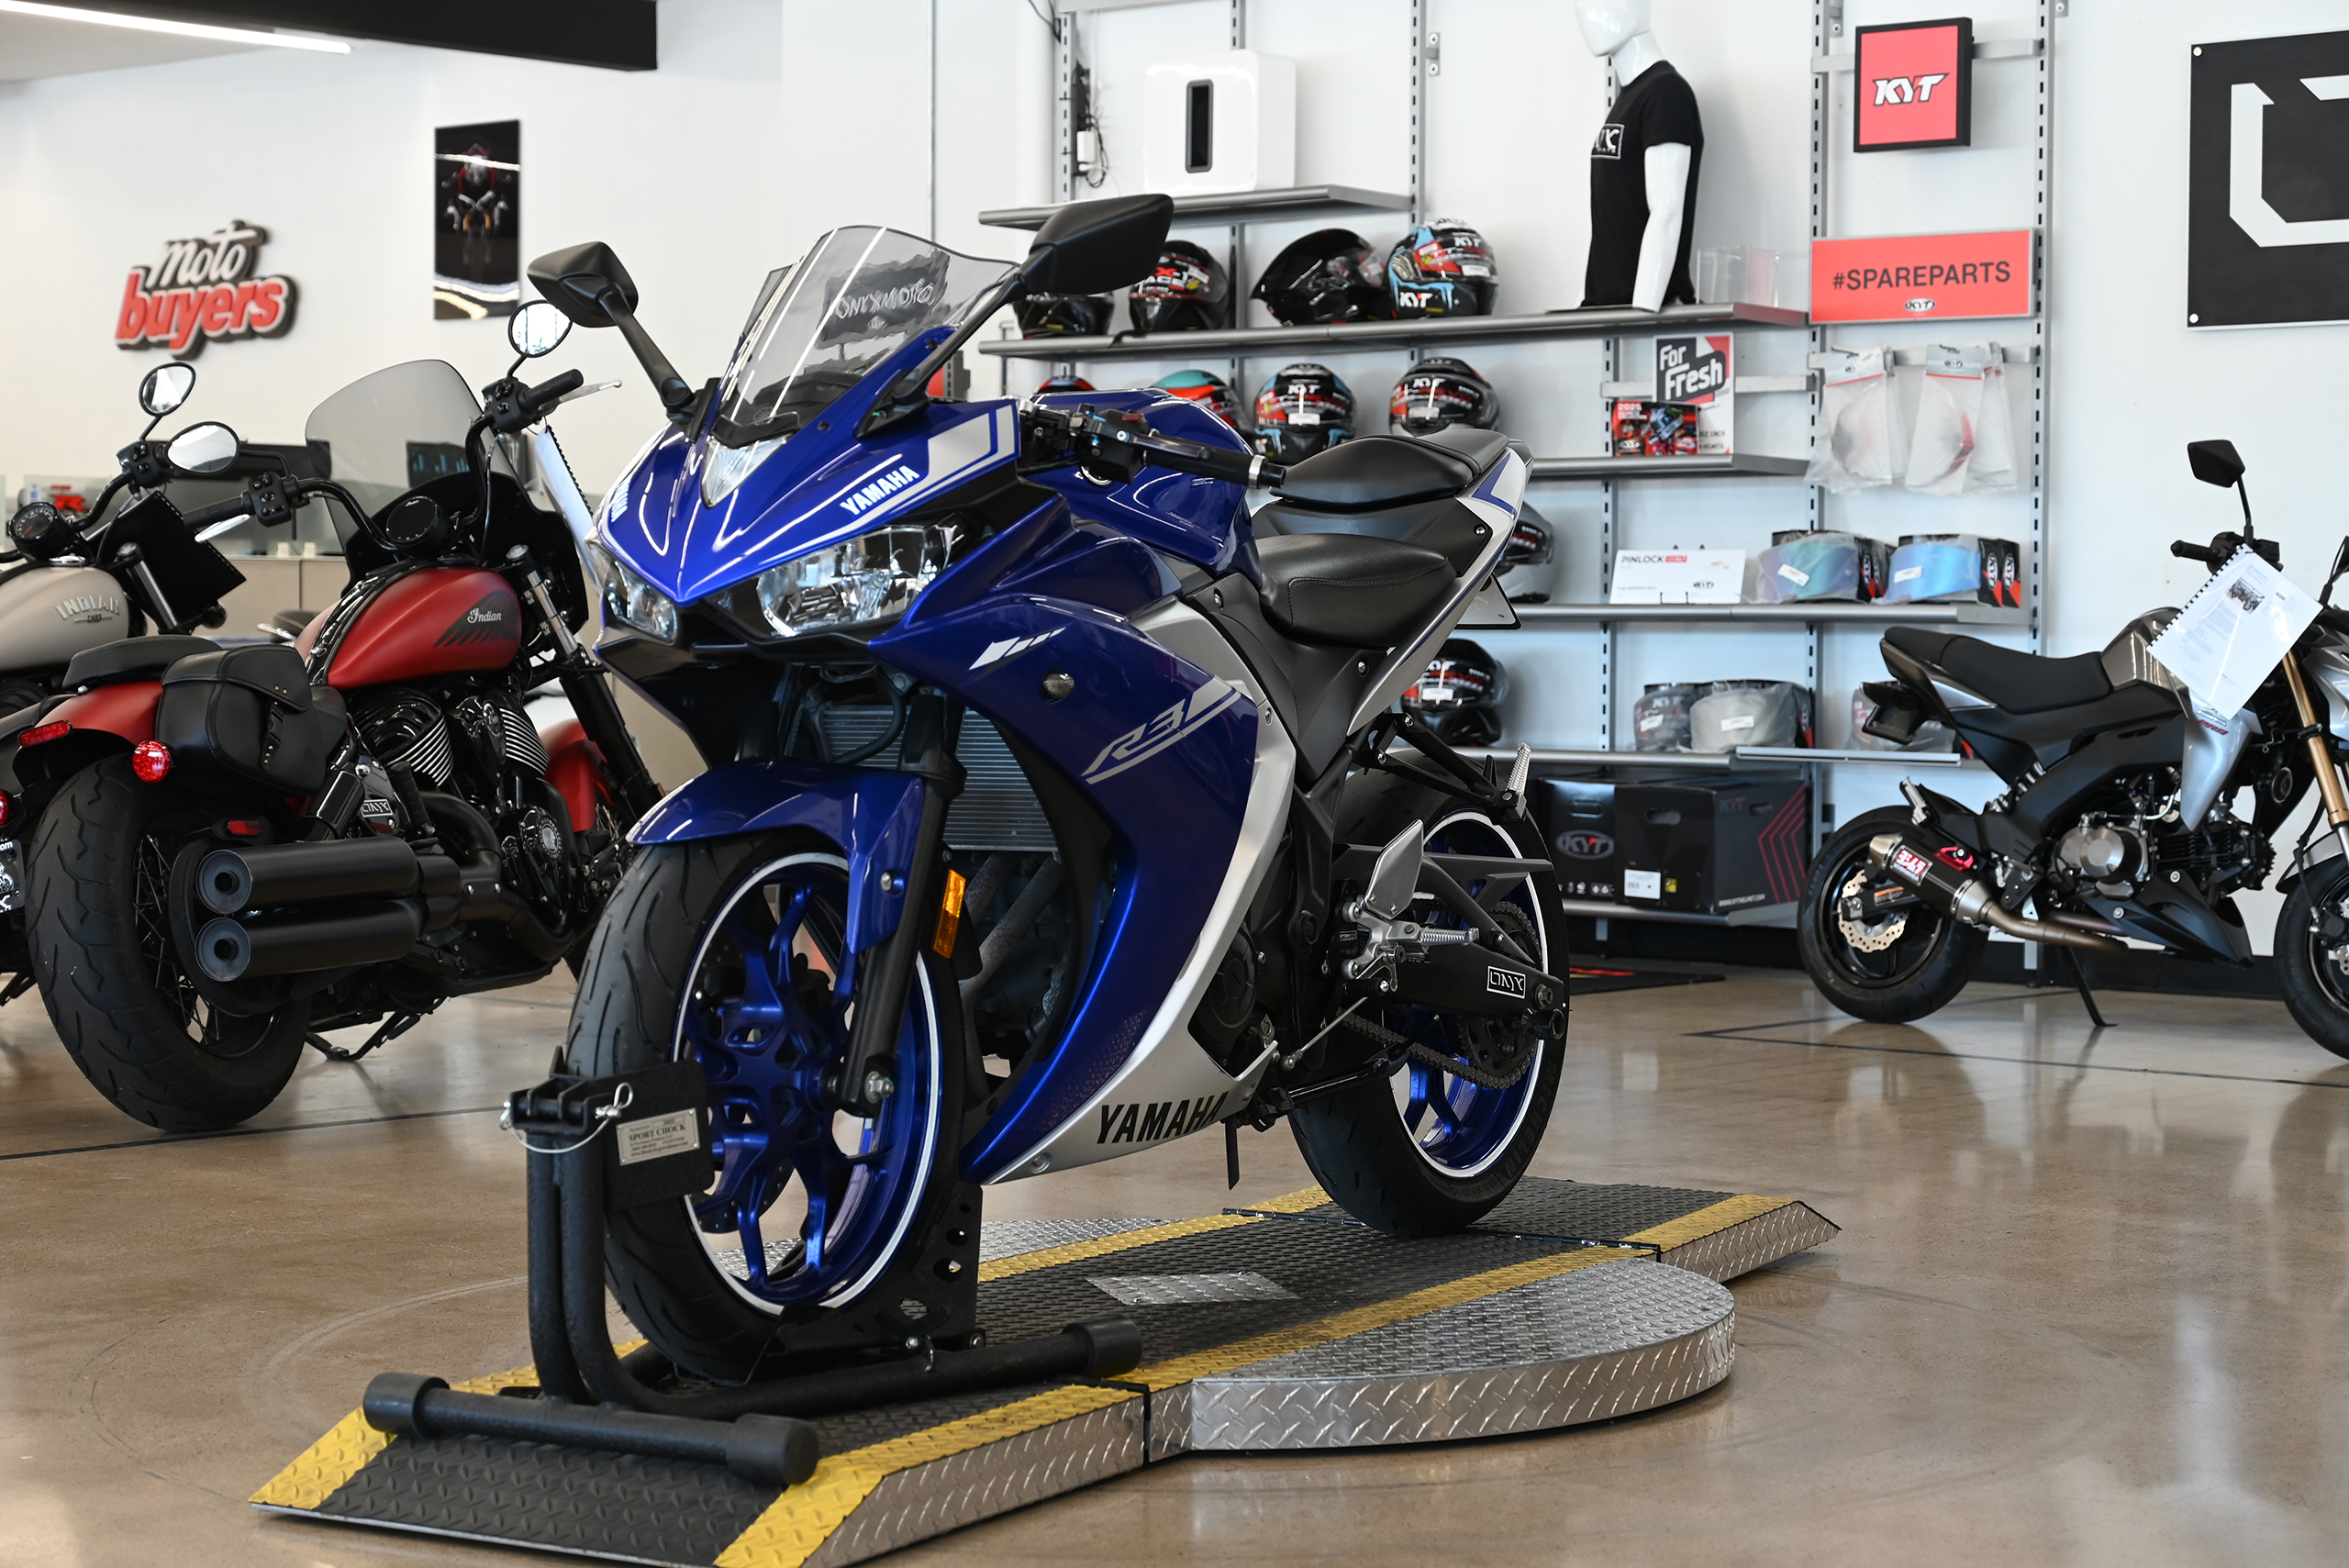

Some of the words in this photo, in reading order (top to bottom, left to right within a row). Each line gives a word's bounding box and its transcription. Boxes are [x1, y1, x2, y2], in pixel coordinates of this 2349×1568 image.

[1872, 72, 1950, 106] KYT
[1453, 237, 1483, 247] KYT
[1832, 261, 2010, 291] #SPAREPARTS
[116, 268, 287, 355] buyers
[1399, 292, 1433, 308] KYT
[1906, 299, 1935, 310] KYT
[1659, 344, 1687, 371] For
[1413, 377, 1446, 388] KYT
[1664, 358, 1723, 401] Fresh
[840, 465, 920, 516] YAMAHA
[1620, 554, 1664, 563] PINLOCK
[55, 595, 120, 620] INDIAN
[466, 607, 502, 624] Indian
[1080, 698, 1186, 777] R3
[1561, 836, 1612, 854] KYT
[1097, 1091, 1229, 1144] YAMAHA
[1504, 1061, 1557, 1176] MICHELIN
[628, 1129, 655, 1142] SPORT
[656, 1124, 686, 1137] CHOCK
[1472, 1179, 1497, 1195] 150/60
